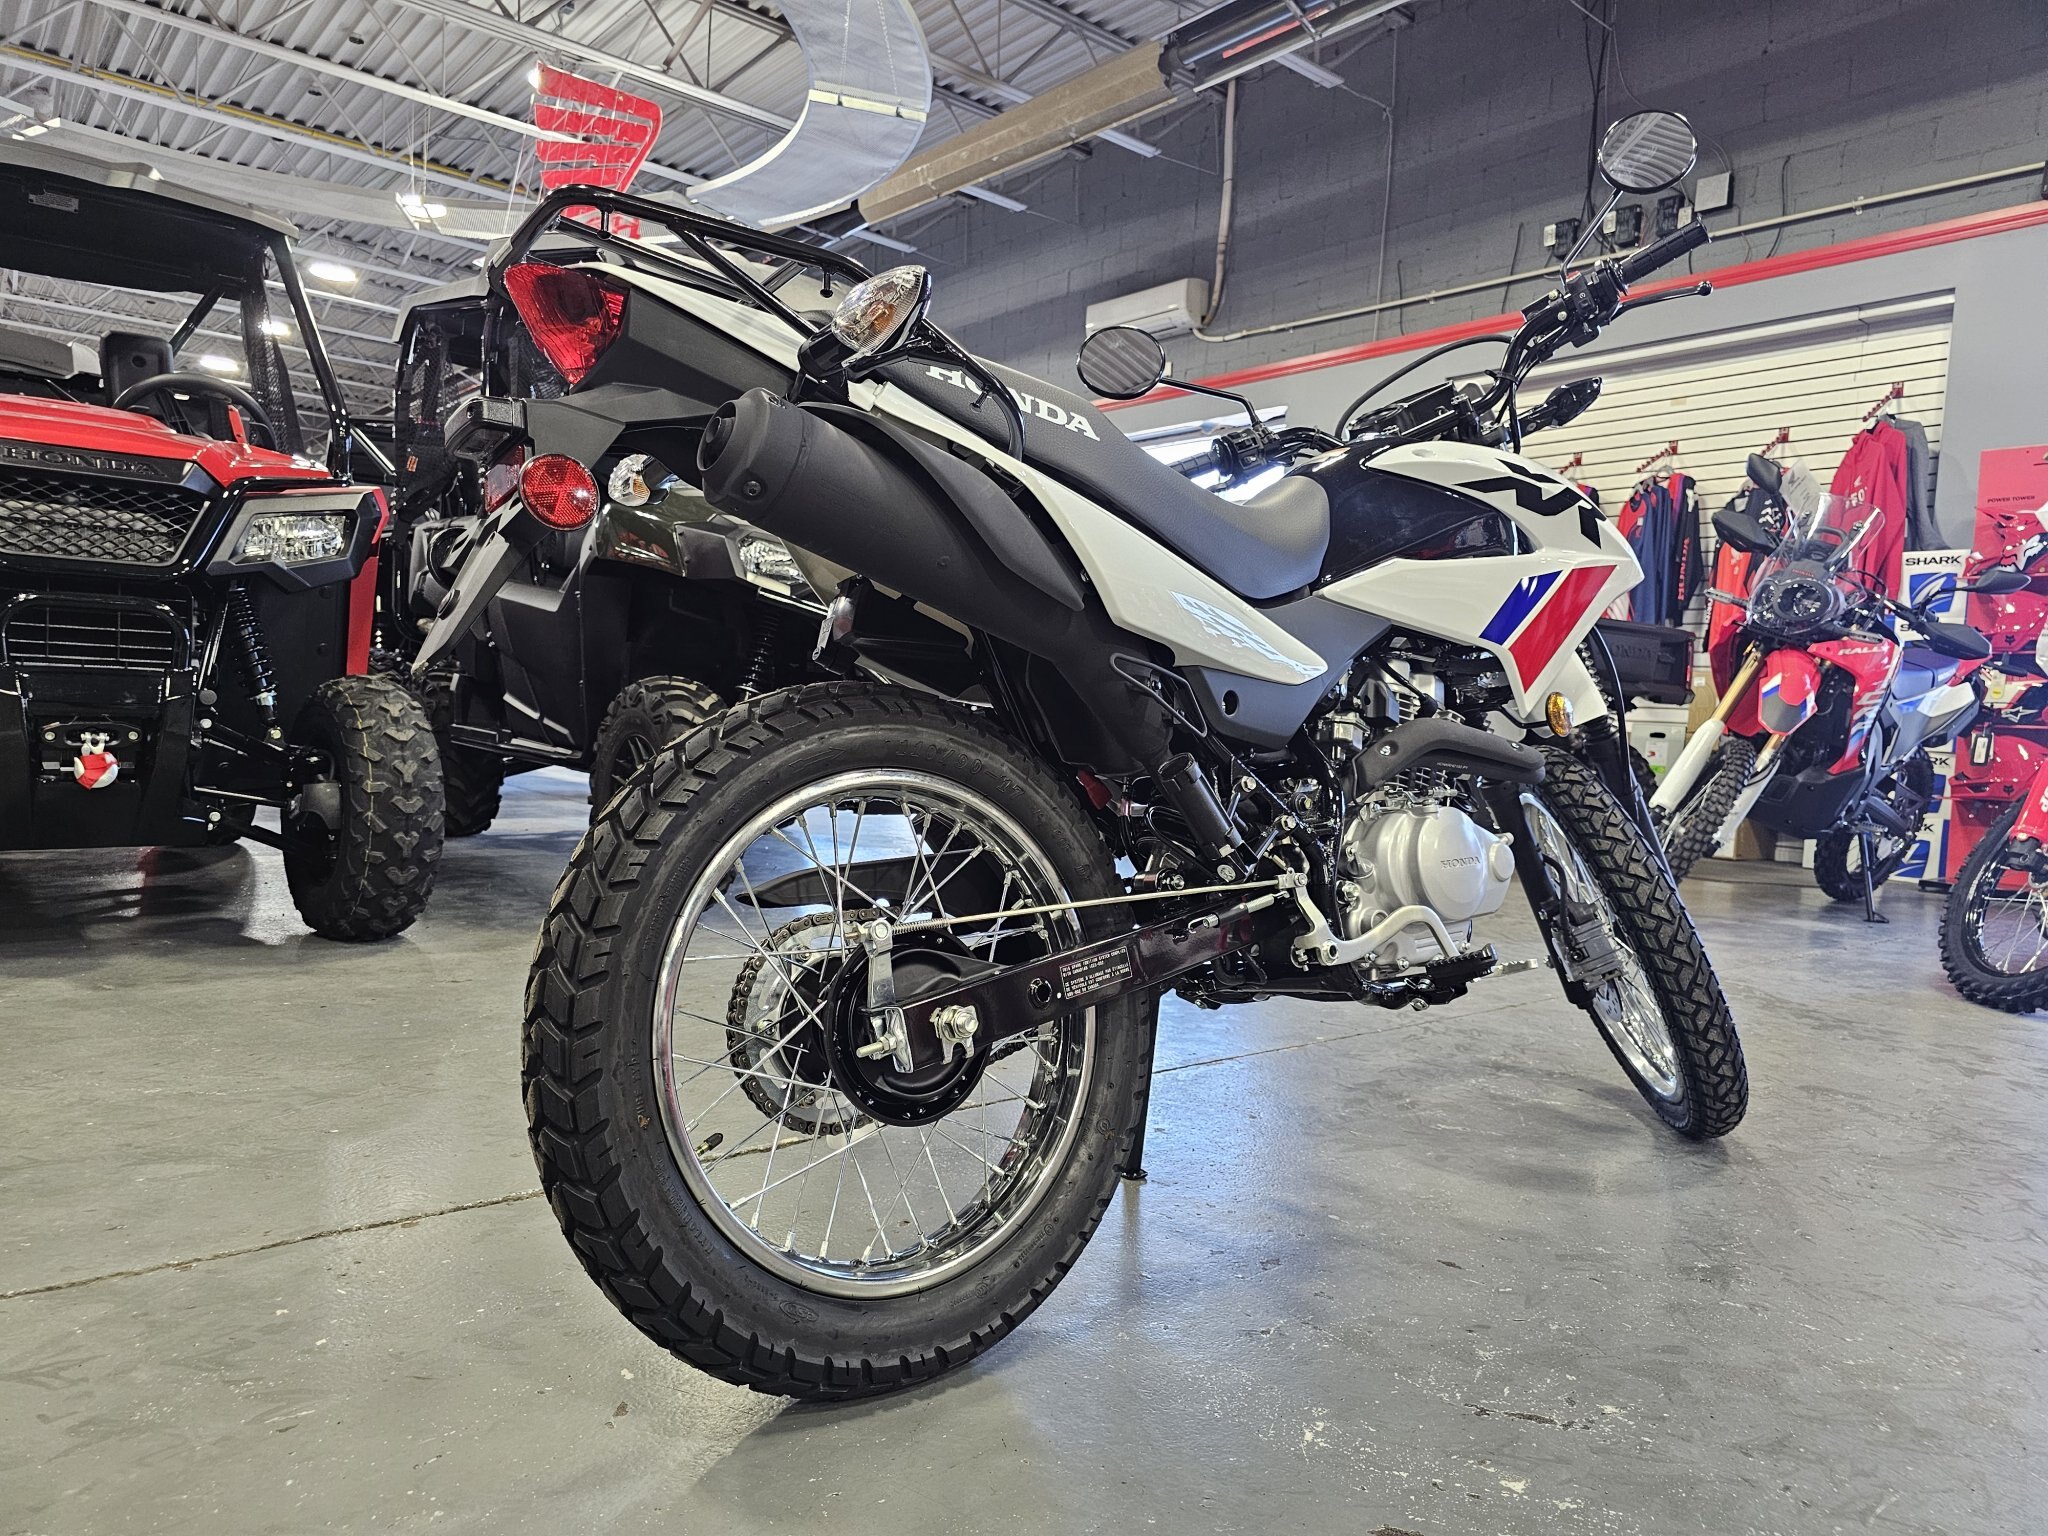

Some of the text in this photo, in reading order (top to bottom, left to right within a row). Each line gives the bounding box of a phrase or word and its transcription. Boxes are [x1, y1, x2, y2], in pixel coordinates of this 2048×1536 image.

[3, 446, 168, 477] HONDA
[1904, 555, 1962, 566] SHARK
[1440, 856, 1480, 868] HONDA
